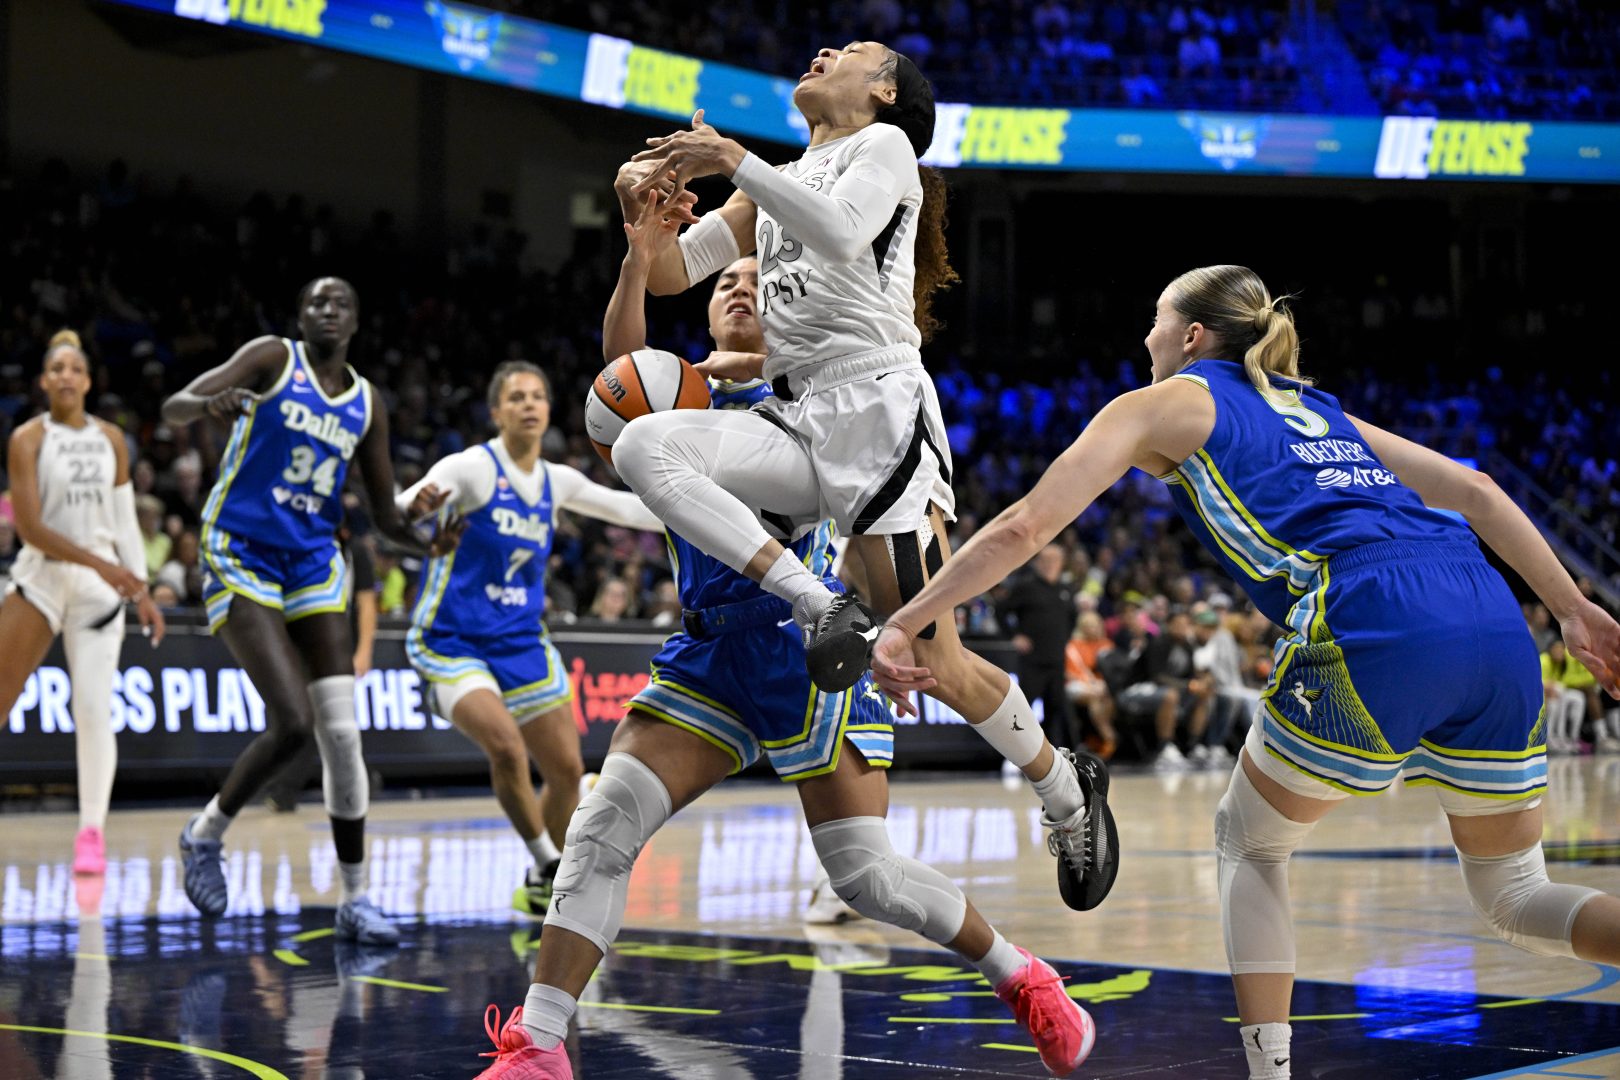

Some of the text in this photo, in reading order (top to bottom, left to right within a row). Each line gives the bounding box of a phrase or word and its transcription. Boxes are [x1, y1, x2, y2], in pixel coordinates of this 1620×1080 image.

[918, 102, 1071, 167] EFENSE
[1256, 389, 1329, 437] 5
[68, 459, 105, 483] 22
[283, 446, 340, 497] 34
[1353, 466, 1397, 487] AT&
[504, 547, 535, 583] 7
[8, 666, 157, 733] PRSS
